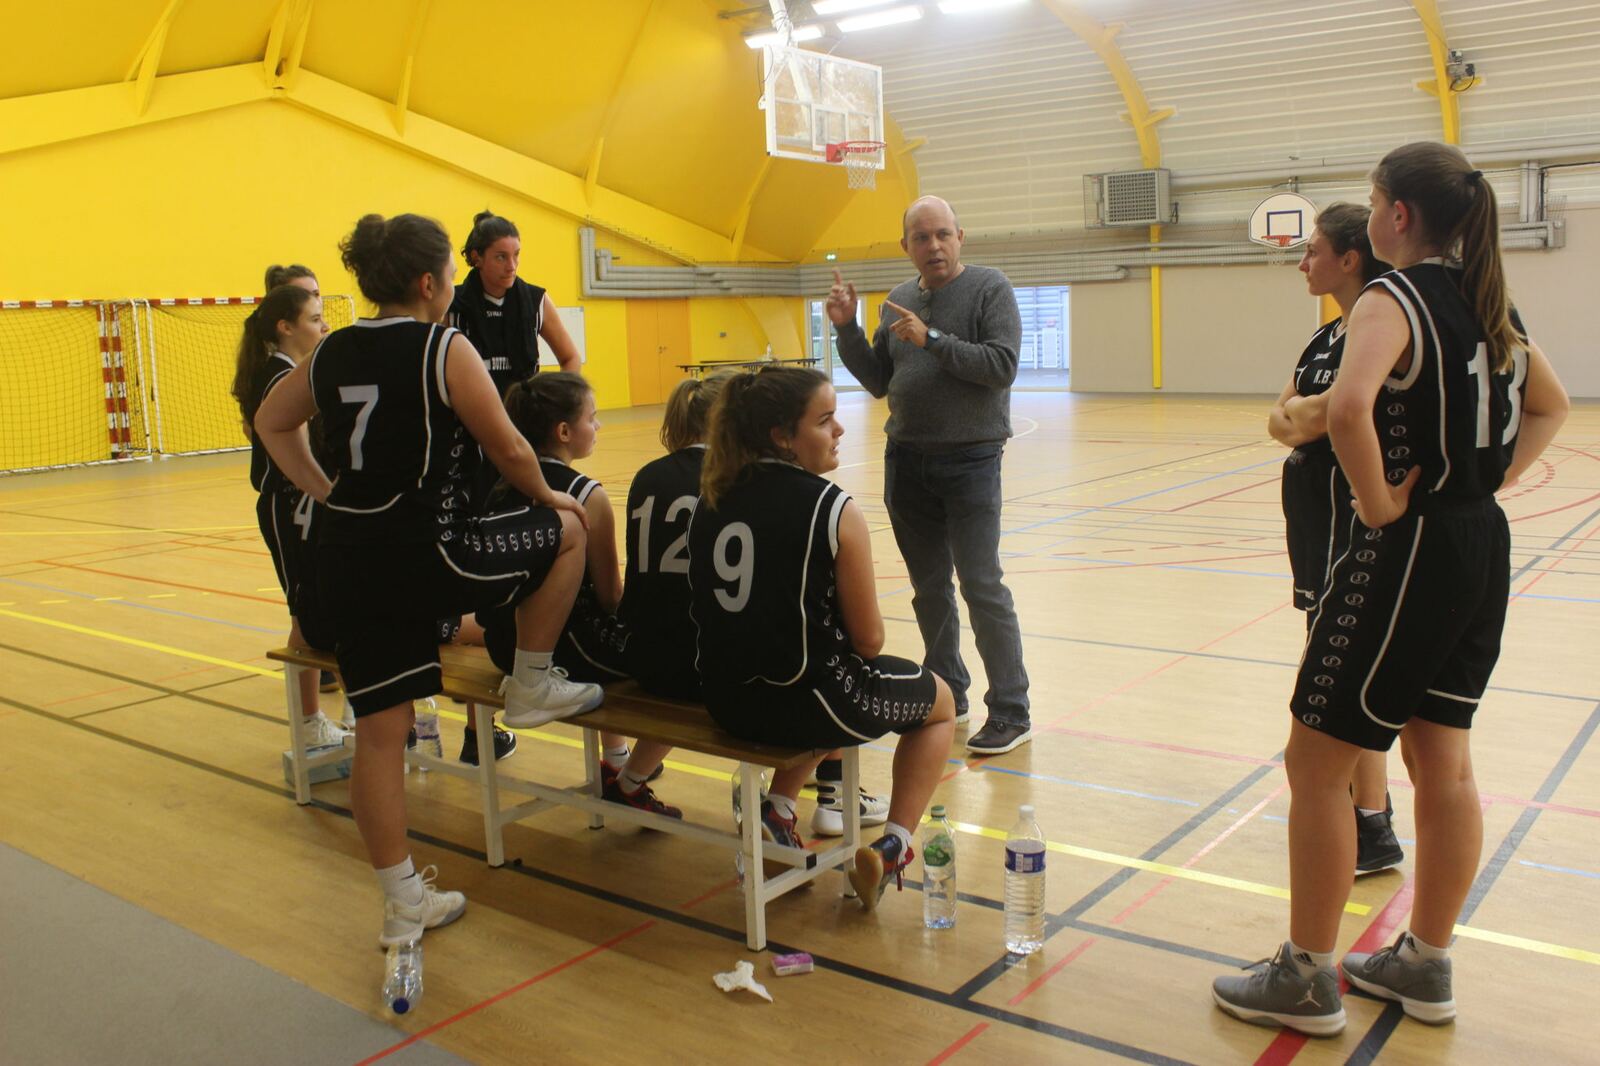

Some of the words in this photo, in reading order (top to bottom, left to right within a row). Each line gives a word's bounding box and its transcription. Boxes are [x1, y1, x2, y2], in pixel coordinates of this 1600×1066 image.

[338, 384, 379, 471] 7
[1467, 342, 1528, 448] 13
[293, 492, 315, 541] 4
[632, 494, 698, 573] 12
[713, 521, 755, 612] 9
